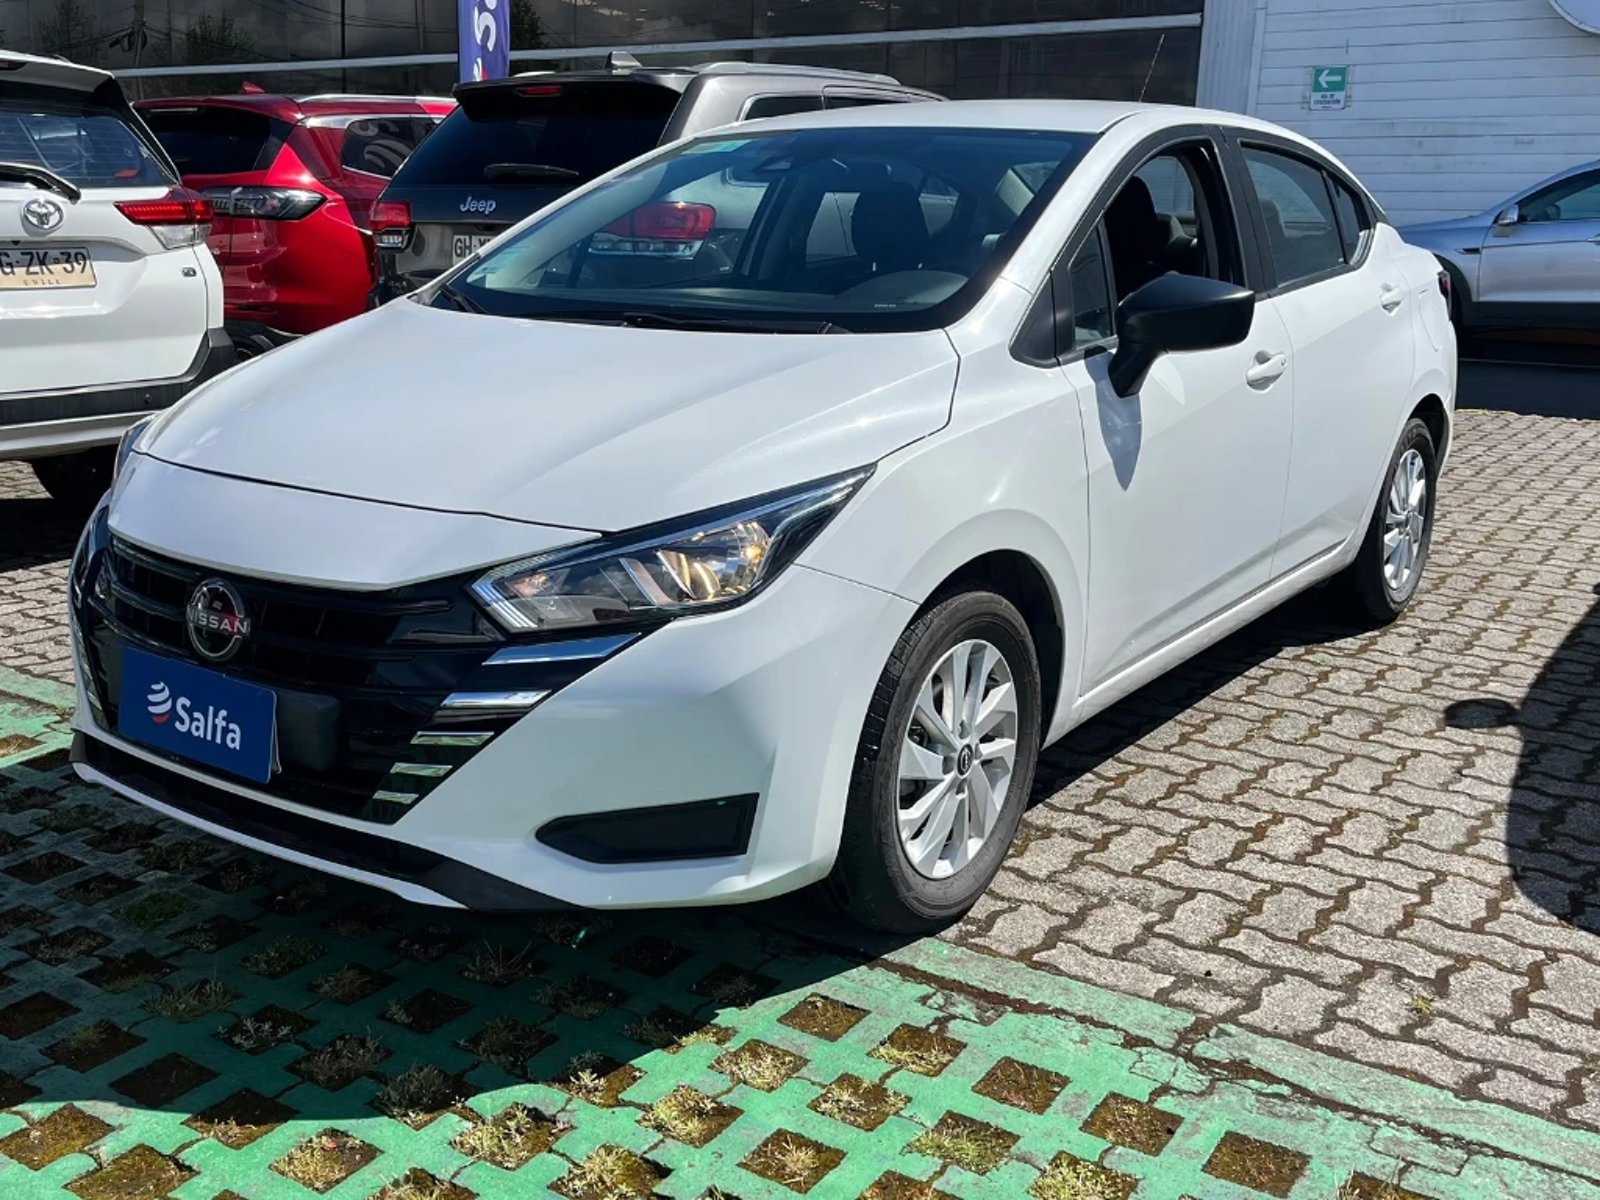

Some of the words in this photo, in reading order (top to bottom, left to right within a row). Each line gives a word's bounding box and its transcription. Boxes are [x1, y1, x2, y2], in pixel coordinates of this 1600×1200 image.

[460, 196, 496, 215] Jeep
[188, 607, 248, 634] NISSAN
[174, 696, 242, 751] Salfa
